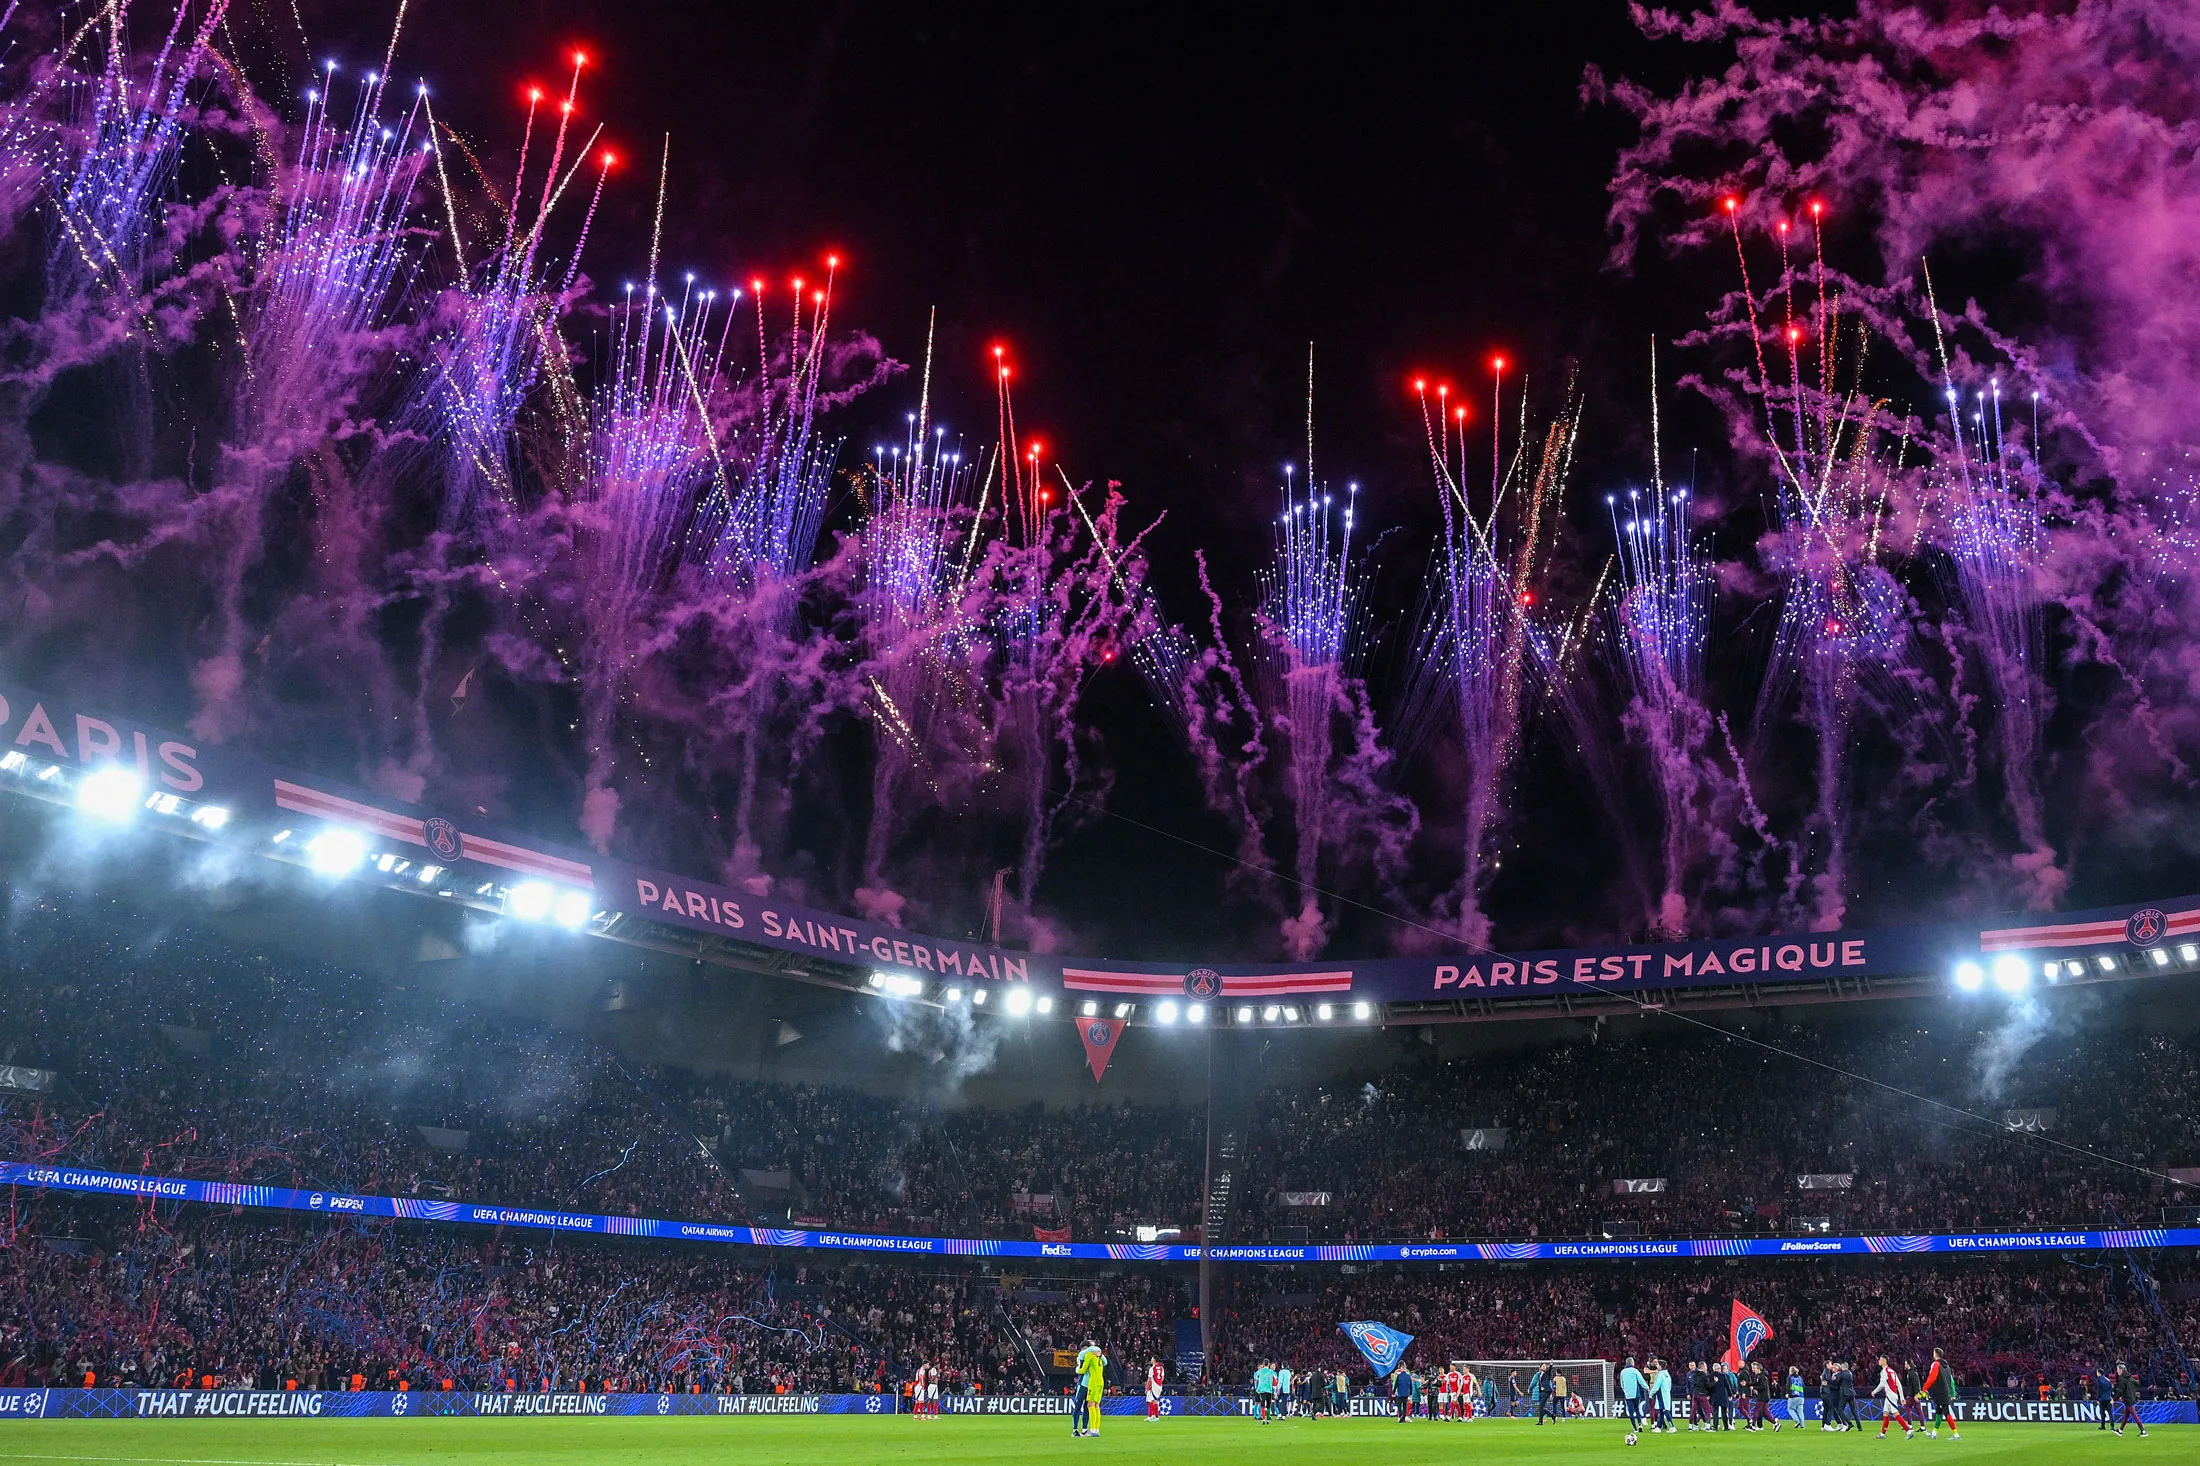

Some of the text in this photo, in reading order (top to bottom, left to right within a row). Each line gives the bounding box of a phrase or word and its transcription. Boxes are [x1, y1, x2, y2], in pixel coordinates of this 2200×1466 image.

[0, 693, 203, 791] ARIS
[429, 820, 455, 834] PARIS
[2133, 910, 2160, 921] PARIS
[636, 879, 1028, 985] PARIS SAINT-GERMAIN
[1434, 940, 1866, 989] PARIS EST MAGIQUE
[1191, 970, 1216, 979] PARIS
[27, 1169, 187, 1195] UEFA CHAMPIONS LEAGUE
[473, 1208, 593, 1228] UEFA CHAMPIONS LEAGUE
[681, 1225, 734, 1238] QATAR AIRWAYS
[819, 1235, 933, 1250] UEFA CHAMPIONS LEAGUE
[1948, 1235, 2087, 1248] UEFA CHAMPIONS LEAGUE
[1041, 1244, 1072, 1256] FedEx
[1210, 1249, 1266, 1258] CHAMPIONS
[1268, 1249, 1305, 1258] LEAGUE
[1411, 1246, 1457, 1257] crypto.com
[1554, 1244, 1678, 1255] UEFA CHAMPIONS LEAGUE
[138, 1392, 323, 1415] THAT #UCLFEELING
[513, 1394, 607, 1414] #UCLFEELING
[717, 1396, 819, 1413] THAT #UCLFEELING
[987, 1397, 1084, 1413] #UCLFEELIN
